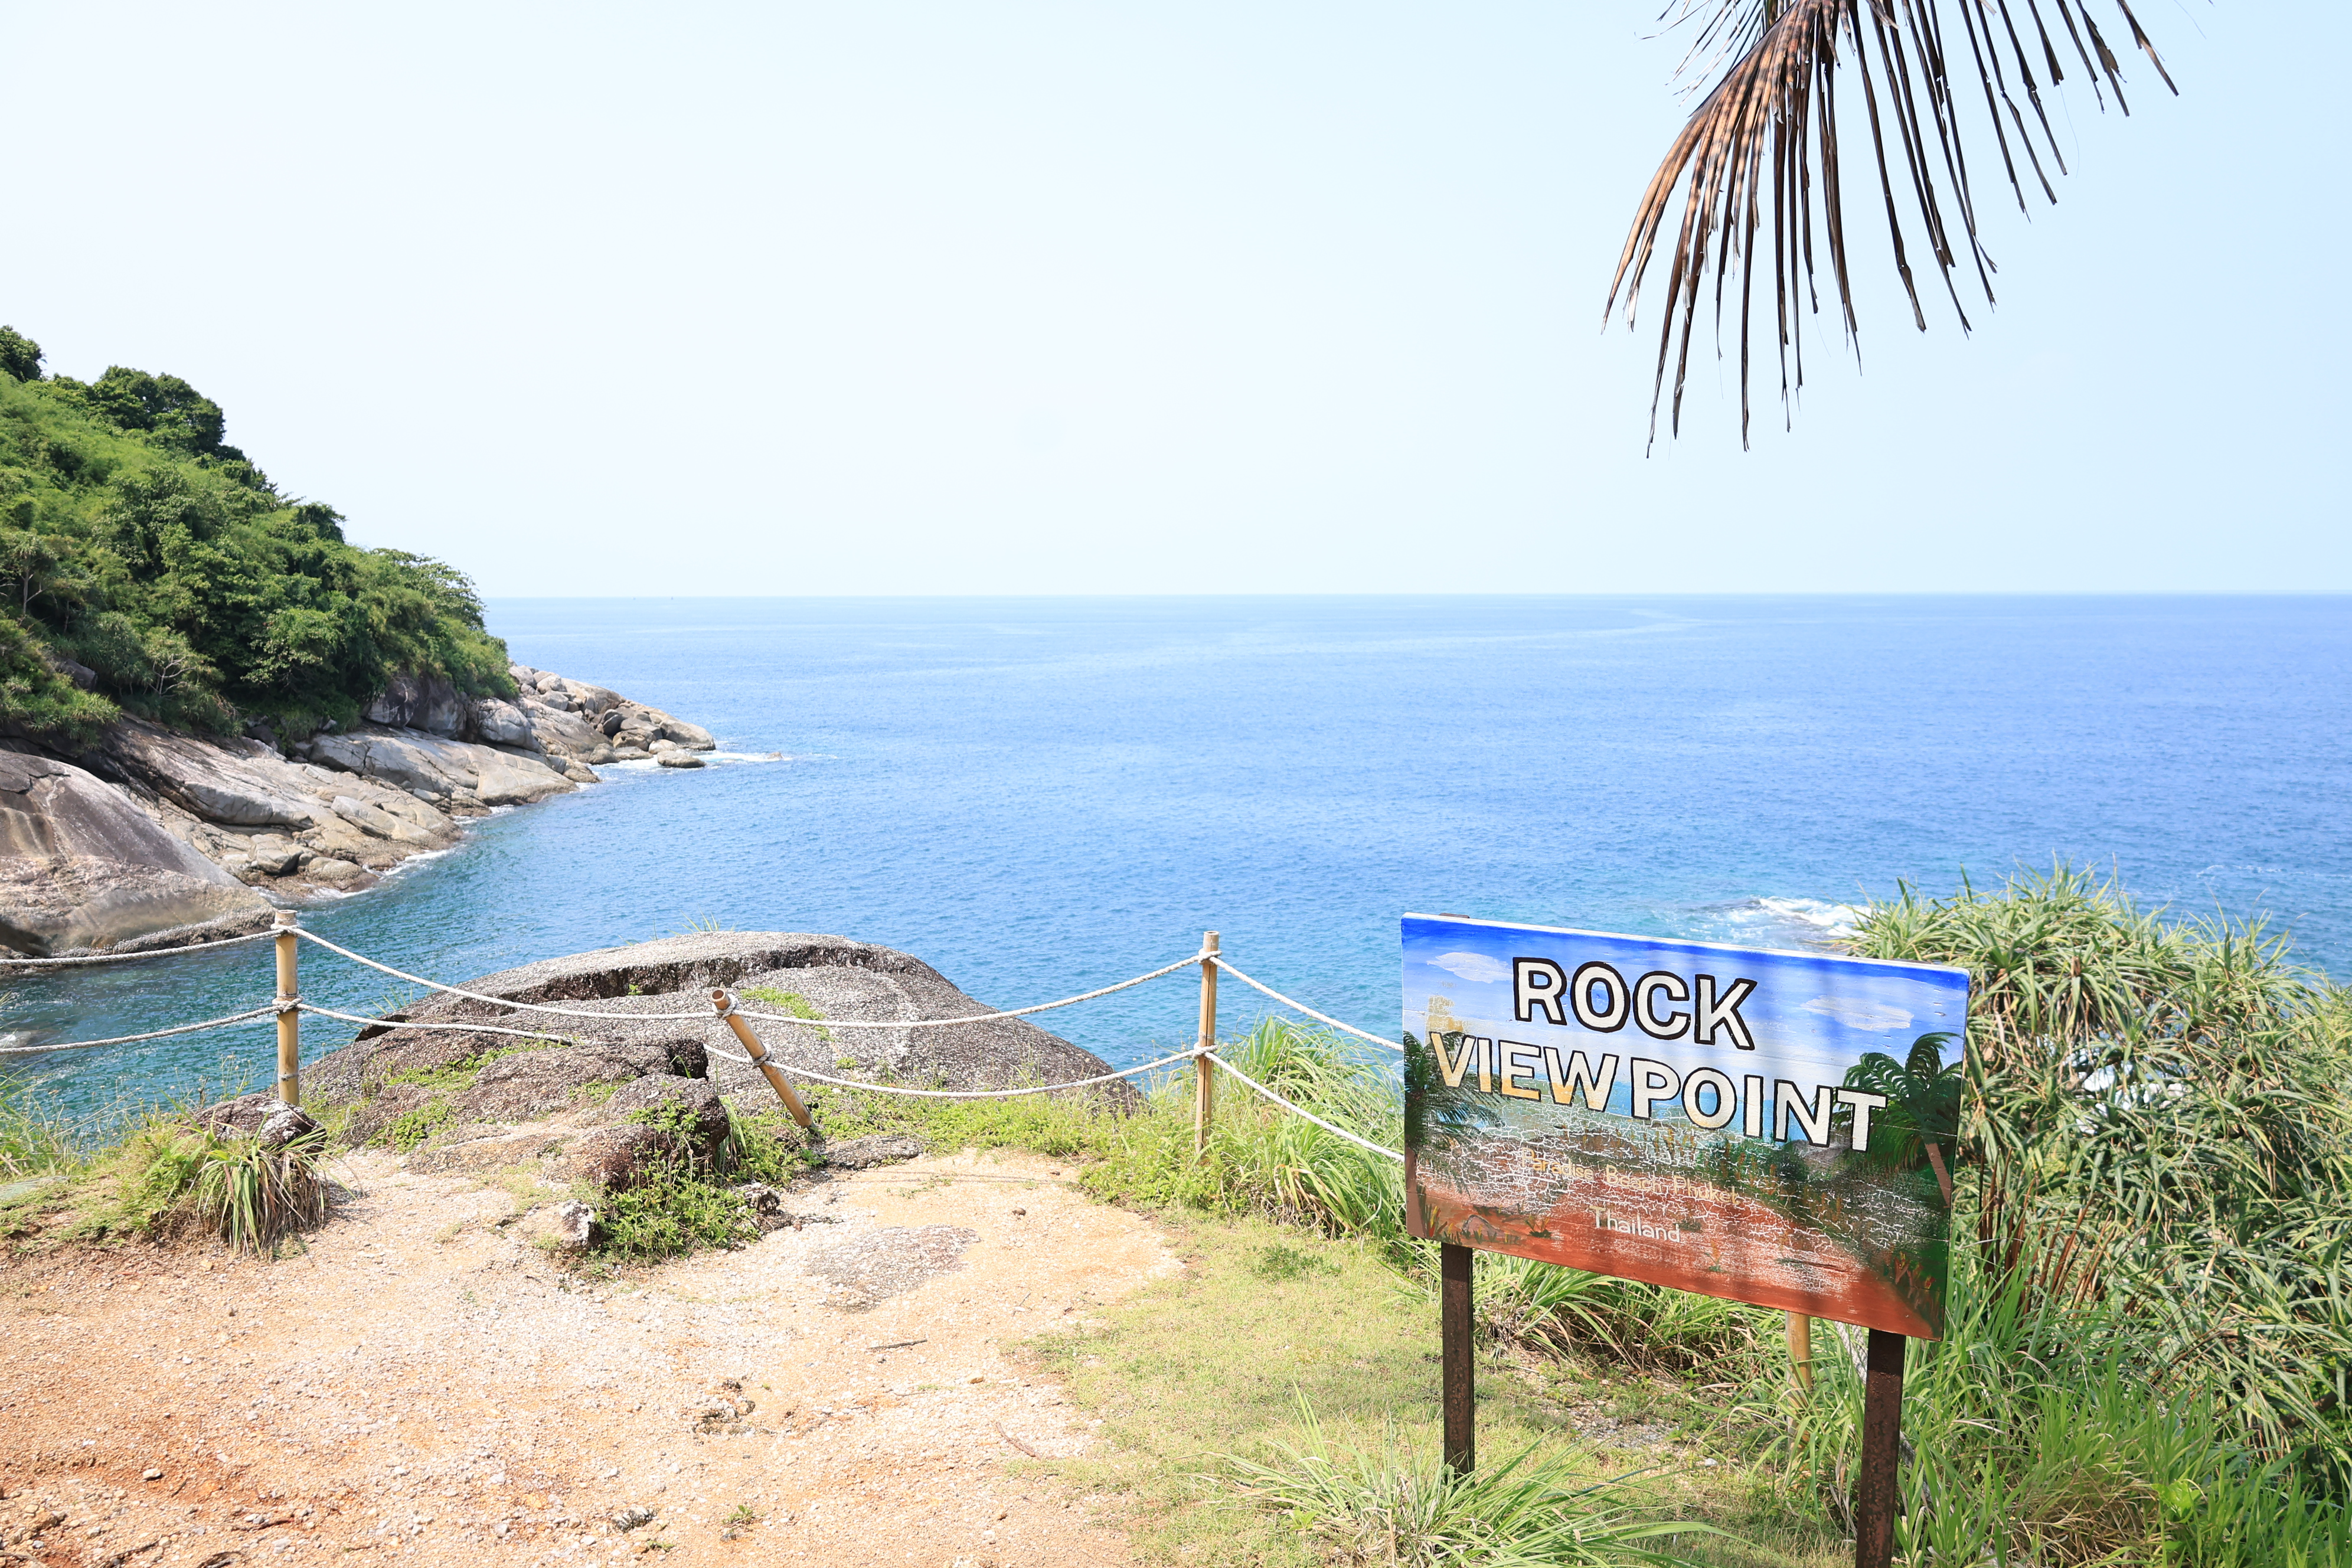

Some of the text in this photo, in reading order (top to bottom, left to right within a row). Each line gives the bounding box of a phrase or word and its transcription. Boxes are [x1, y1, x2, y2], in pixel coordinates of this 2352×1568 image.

[1513, 956, 1758, 1050] ROCK
[1429, 1031, 1887, 1152] VIEW POINT
[1522, 1147, 1740, 1205] Paradise Beach Phuket
[1589, 1205, 1680, 1242] Thailand
